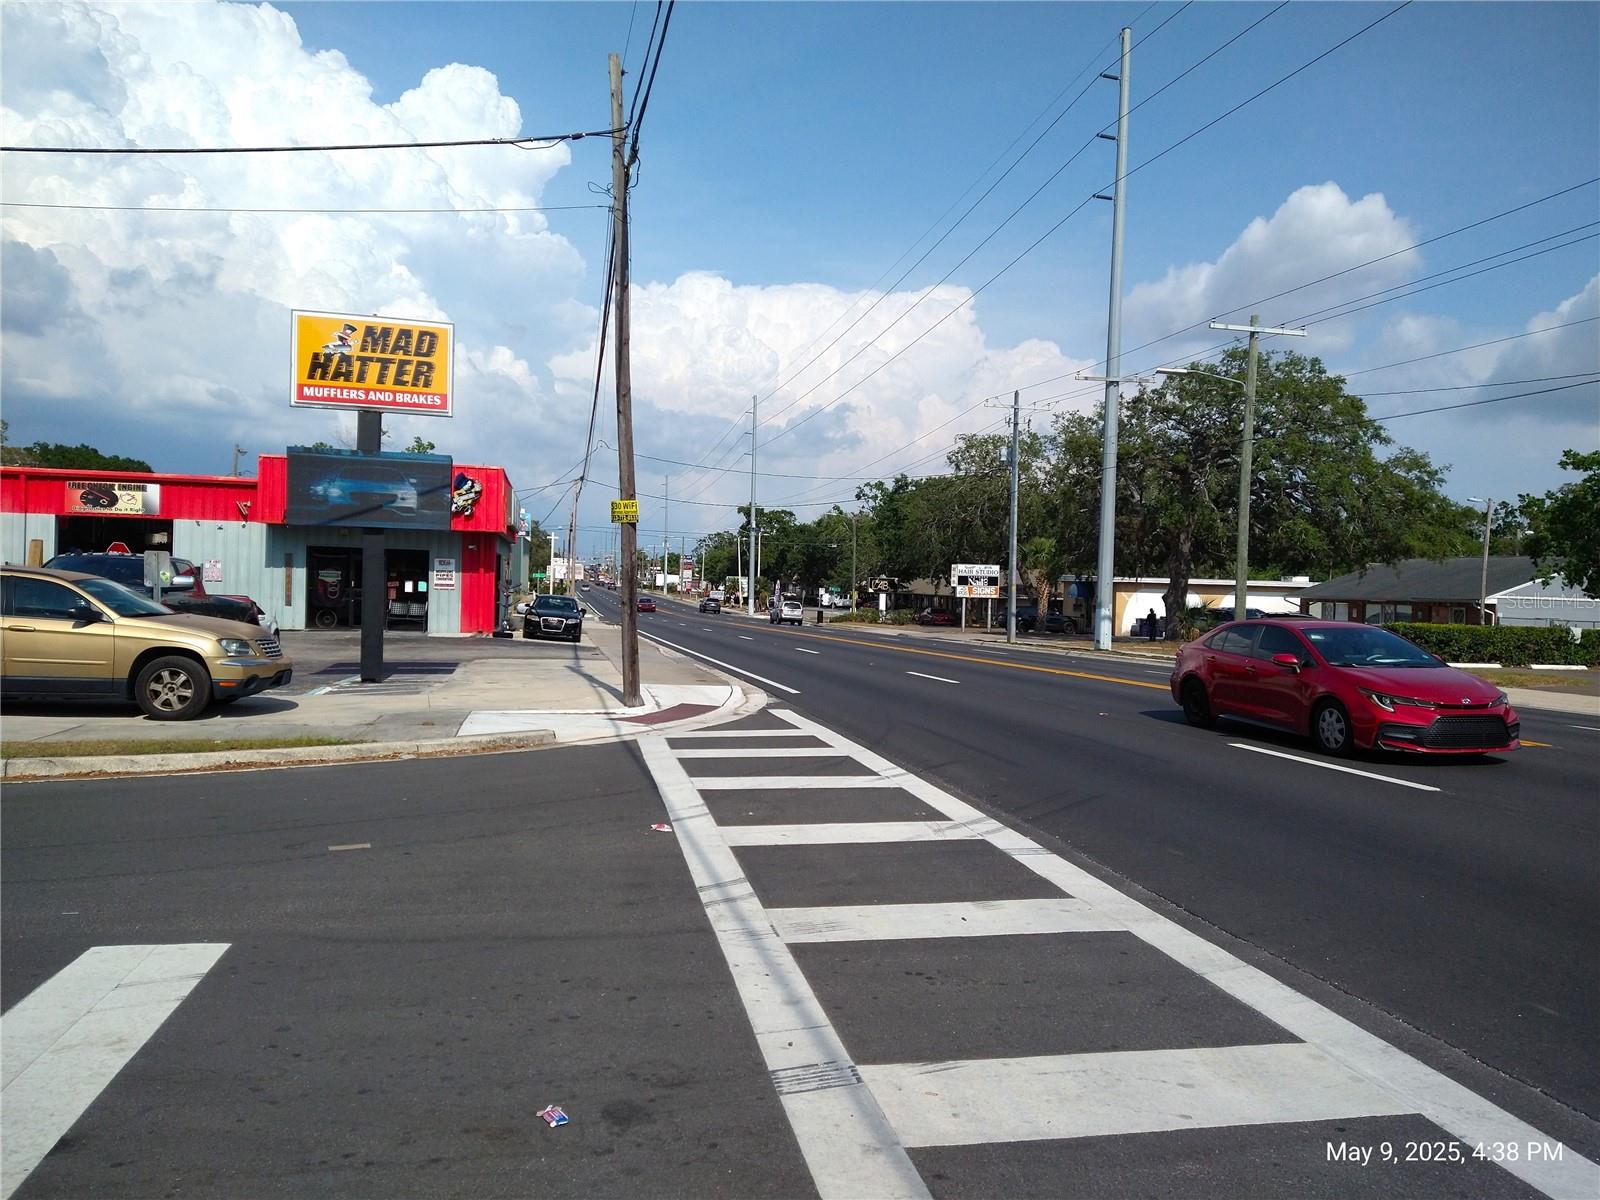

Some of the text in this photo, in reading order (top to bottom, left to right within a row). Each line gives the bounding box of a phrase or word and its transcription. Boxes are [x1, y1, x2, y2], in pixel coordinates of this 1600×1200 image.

[359, 325, 439, 358] MAD
[306, 351, 436, 388] HATTER
[303, 386, 442, 405] MUFFLERS AND BRAKES
[117, 483, 147, 492] ENGINE
[611, 502, 622, 510] $30
[972, 587, 996, 595] SIGNS
